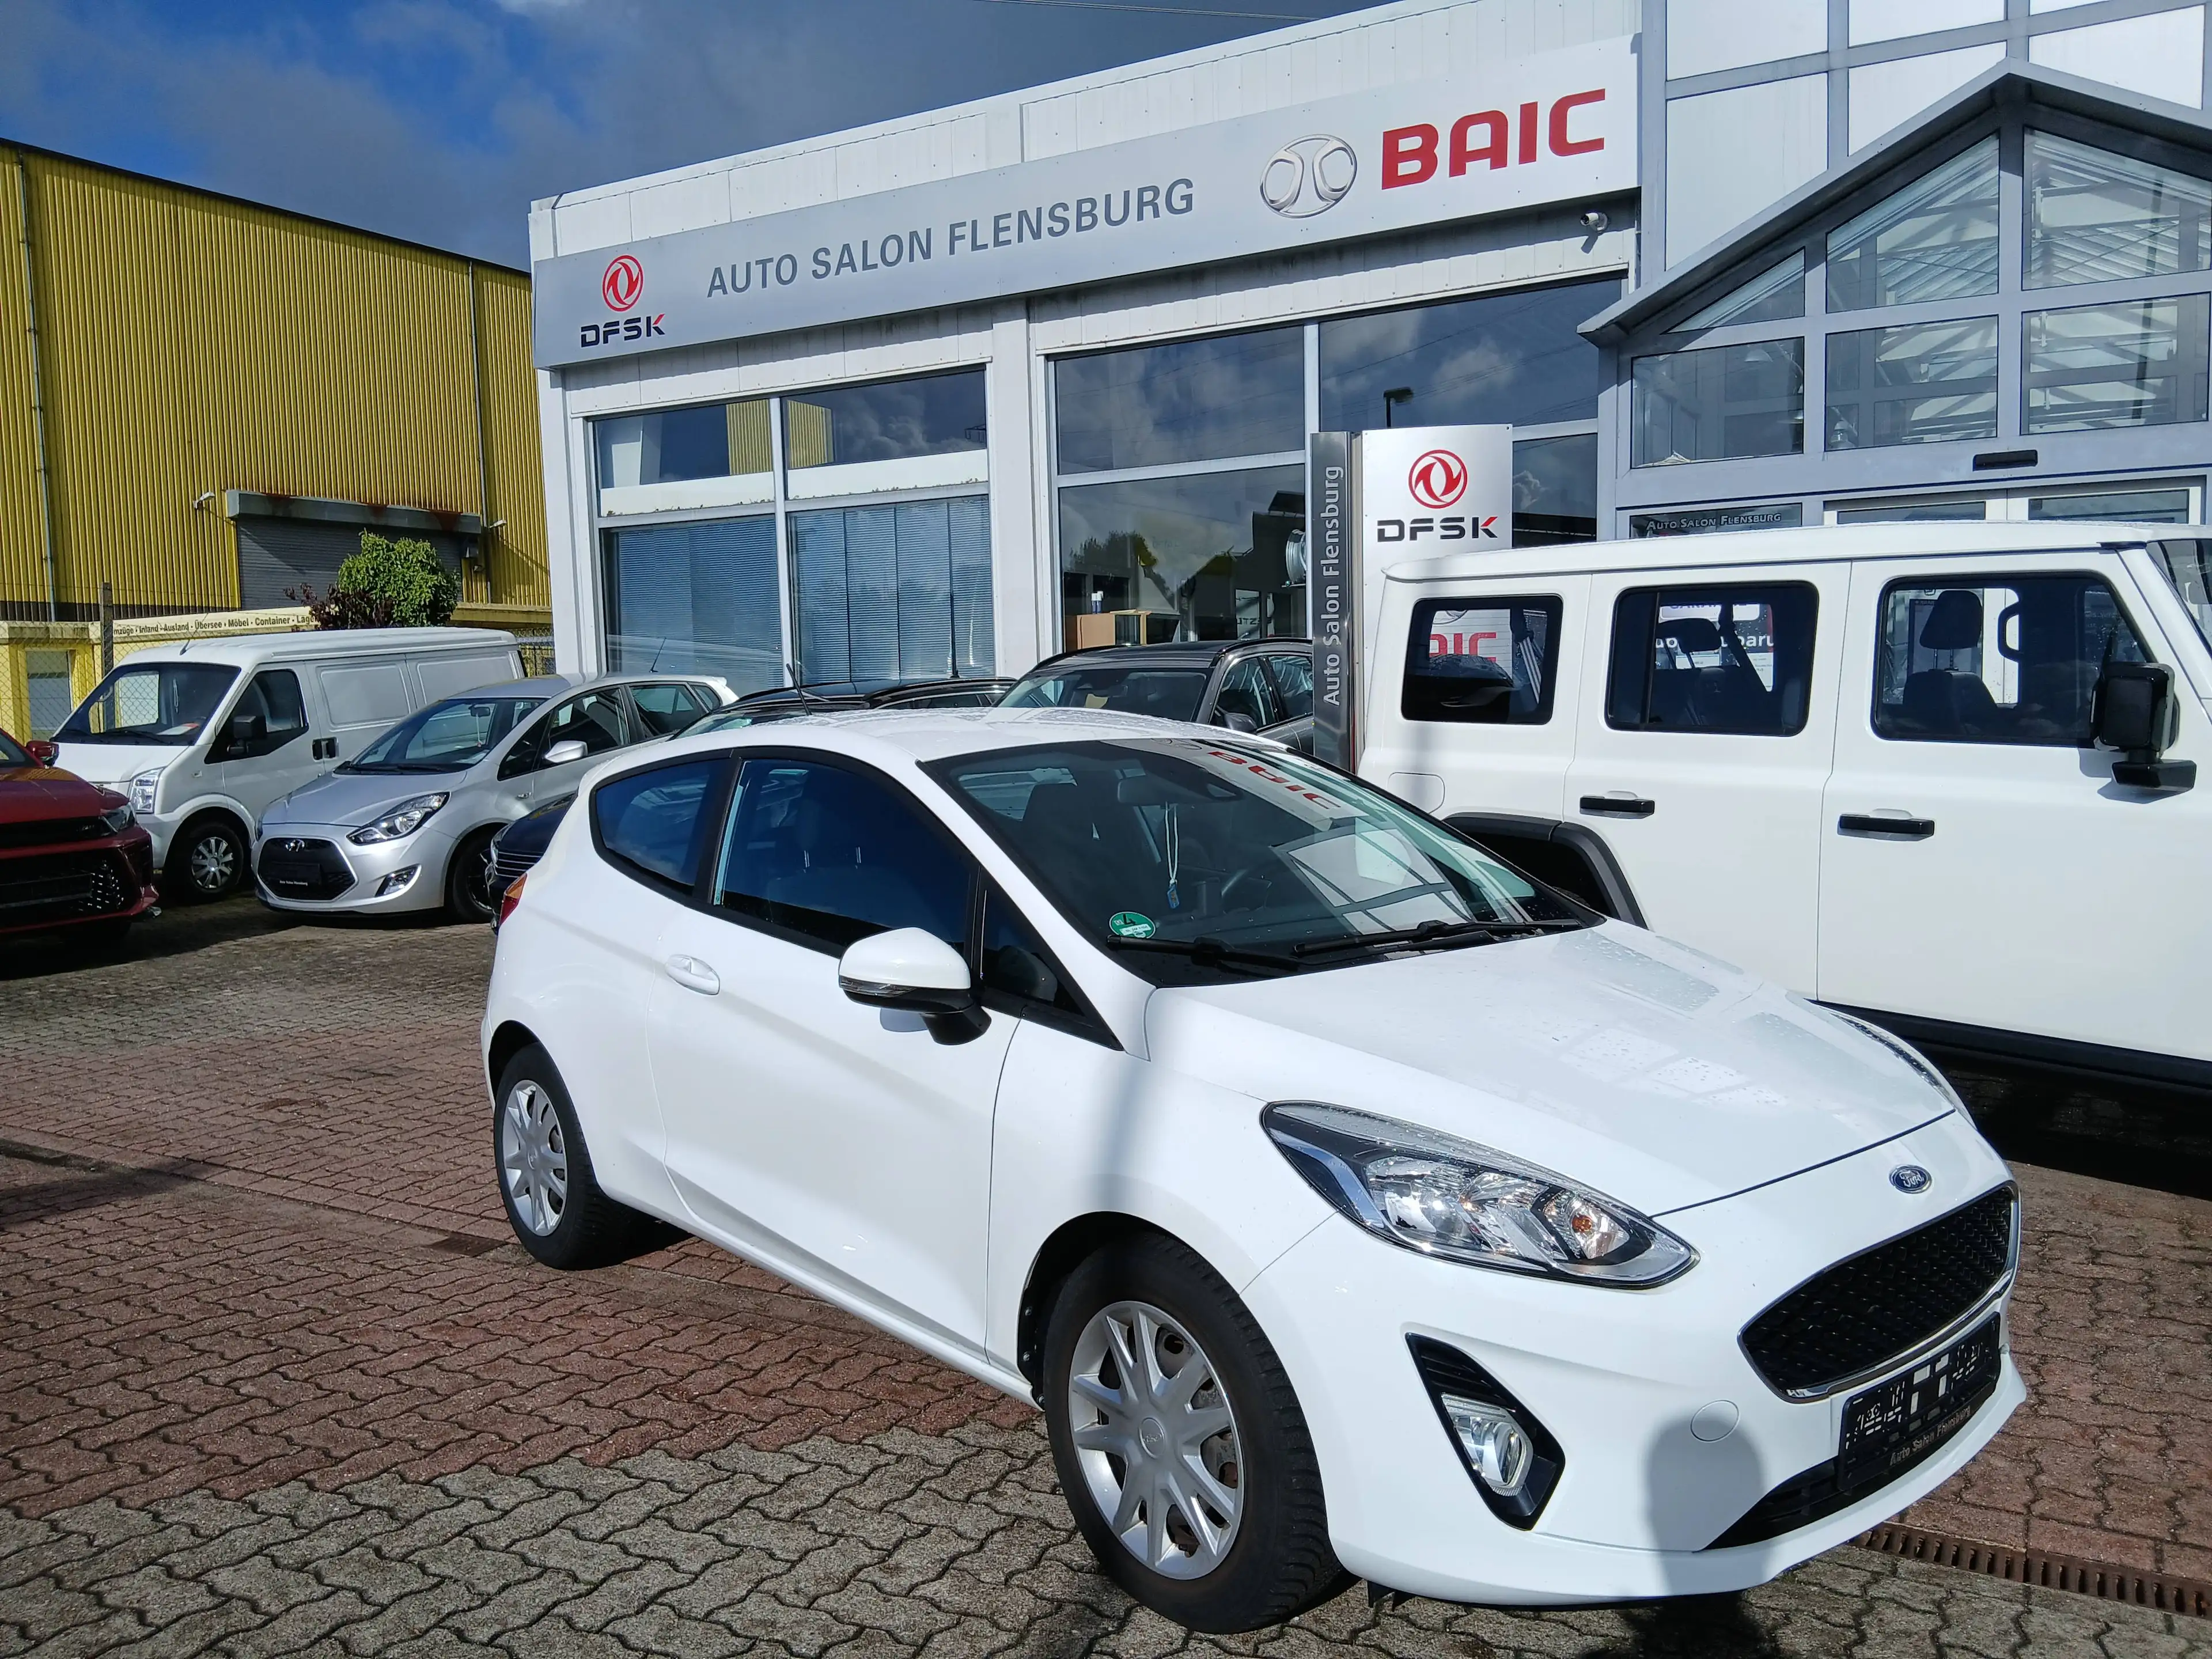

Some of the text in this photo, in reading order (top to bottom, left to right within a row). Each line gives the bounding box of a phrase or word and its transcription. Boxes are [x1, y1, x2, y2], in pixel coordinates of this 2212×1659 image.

[1382, 88, 1605, 190] BAIC
[707, 178, 1195, 299] AUTO SALON FLENSBURG
[581, 313, 666, 348] DFSK
[1377, 516, 1498, 543] DFSK
[1320, 465, 1344, 706] Auto Salon Flensburg
[113, 624, 134, 636] mzüge
[139, 624, 158, 633] Inland
[164, 622, 189, 631] Ausland
[194, 619, 222, 630] Übersee
[228, 618, 249, 628] Möbel
[255, 616, 290, 626] Container
[1899, 1170, 1925, 1187] Ford
